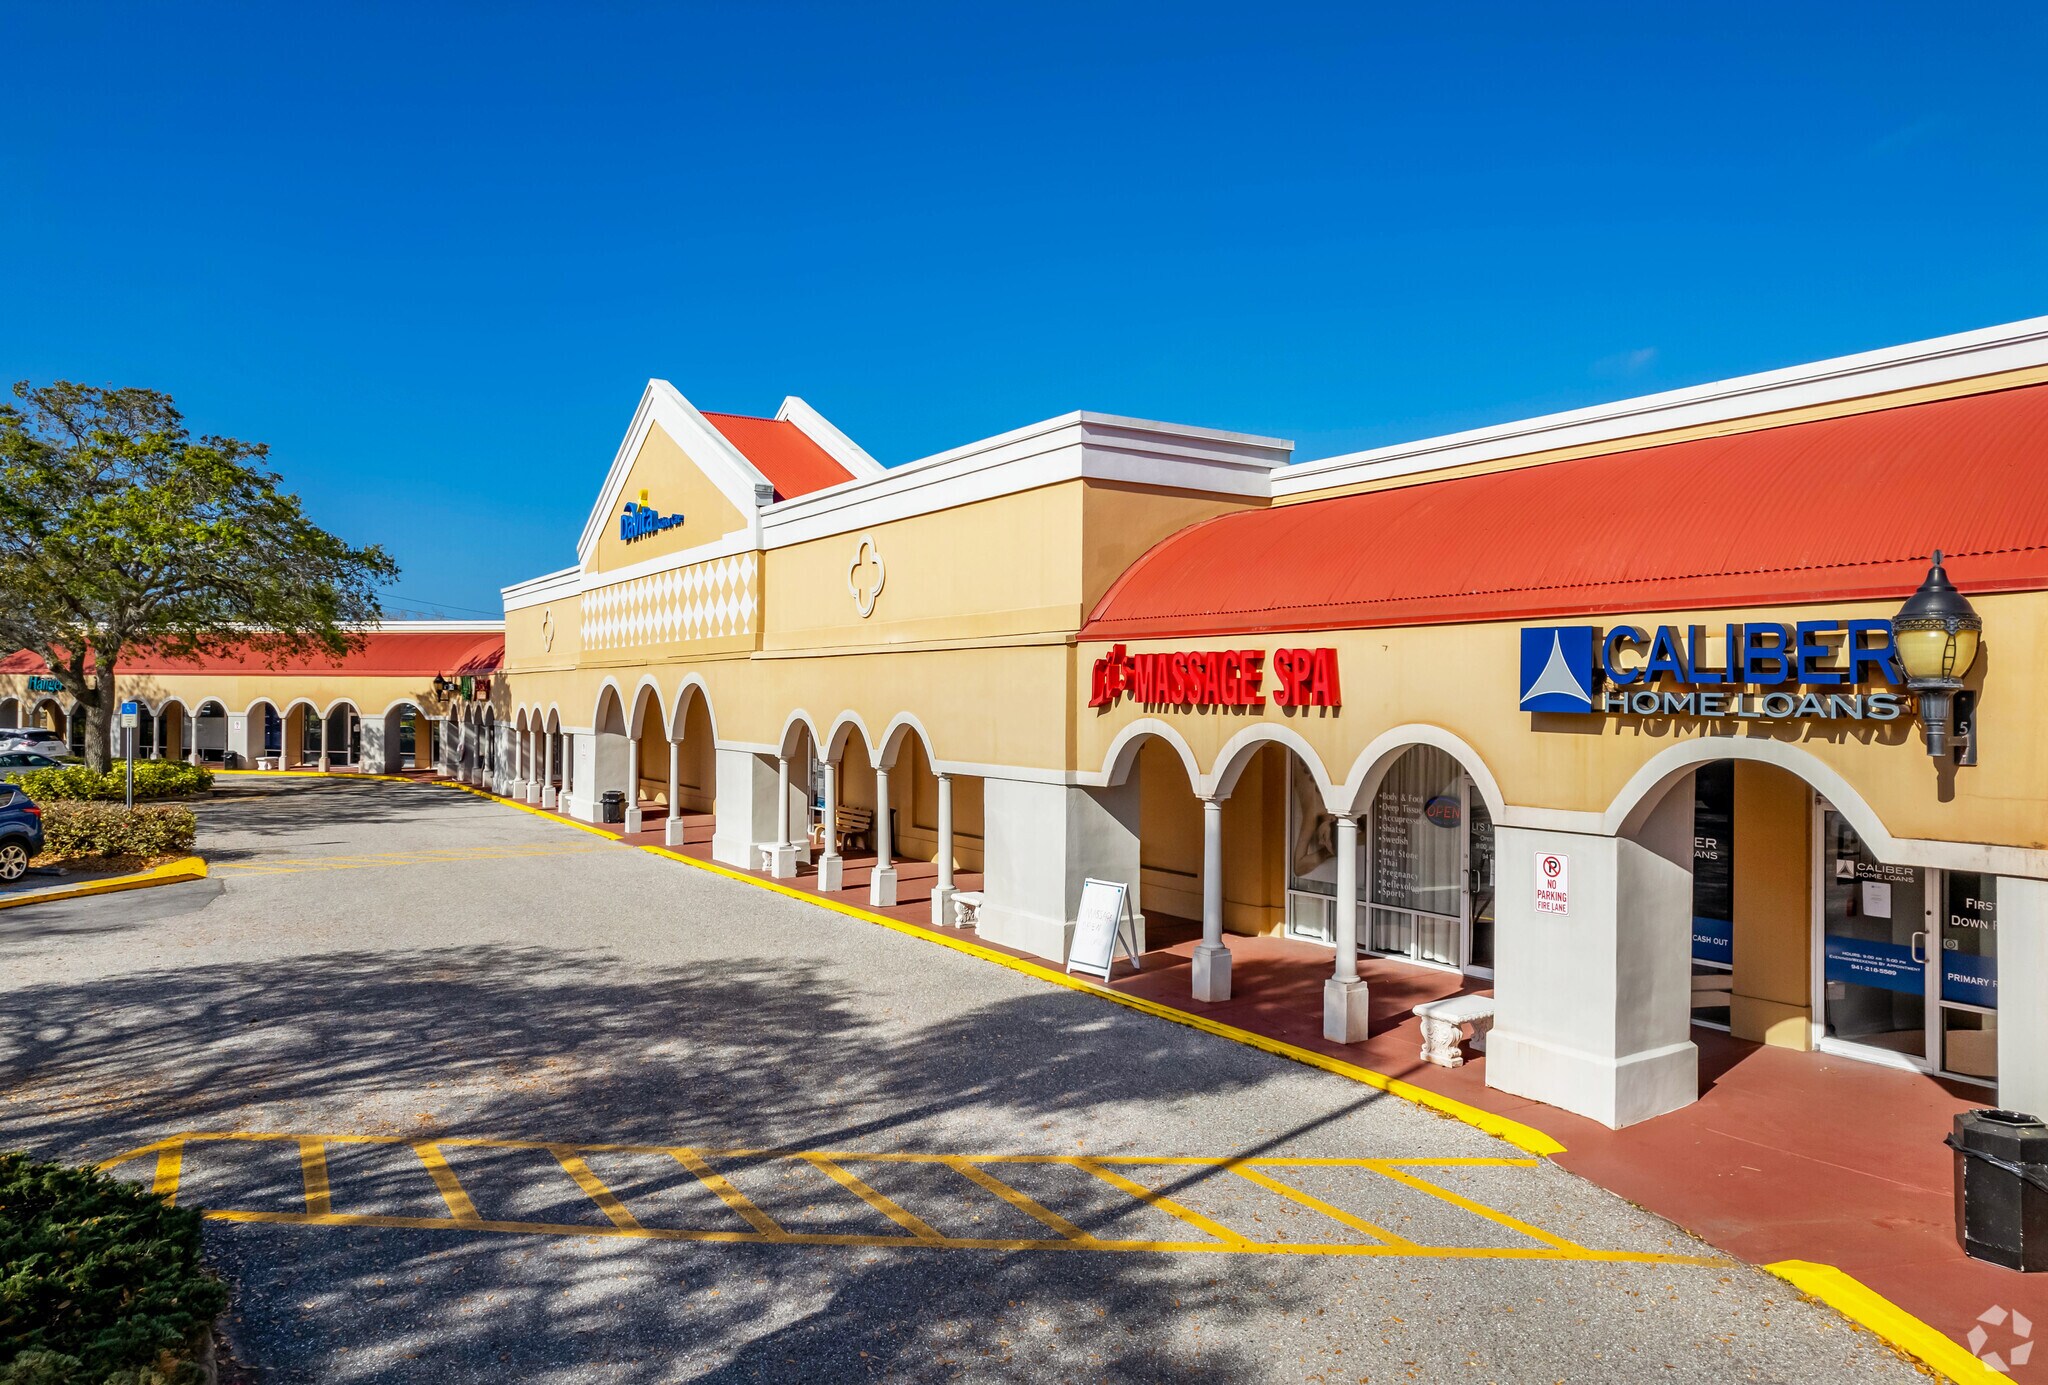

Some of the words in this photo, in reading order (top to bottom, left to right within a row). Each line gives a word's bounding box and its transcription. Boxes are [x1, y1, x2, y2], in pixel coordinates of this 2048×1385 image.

[621, 502, 658, 540] DaVita
[1602, 619, 1901, 685] CALIBER
[1135, 649, 1266, 705] MASSAGE
[1273, 647, 1341, 707] SPA
[29, 676, 64, 692] Hanger
[1604, 691, 1725, 717] HOME
[1737, 692, 1900, 720] LOANS
[1427, 805, 1460, 819] OPEN
[1382, 824, 1406, 834] Shiatsu
[1381, 835, 1409, 845] Swedish
[1383, 858, 1398, 867] Thai
[1857, 862, 1914, 876] CALIBER
[1382, 868, 1418, 881] Pregnancy
[1855, 872, 1882, 880] HOME
[1884, 874, 1915, 884] LOANS
[1547, 879, 1557, 889] NO
[1382, 888, 1405, 898] Sports
[1537, 889, 1567, 902] PARKING
[1538, 900, 1550, 910] FIRE
[1552, 903, 1566, 912] LANE
[1692, 934, 1711, 944] CASH
[1713, 937, 1728, 946] OUT
[1947, 972, 1989, 987] PRIMARY
